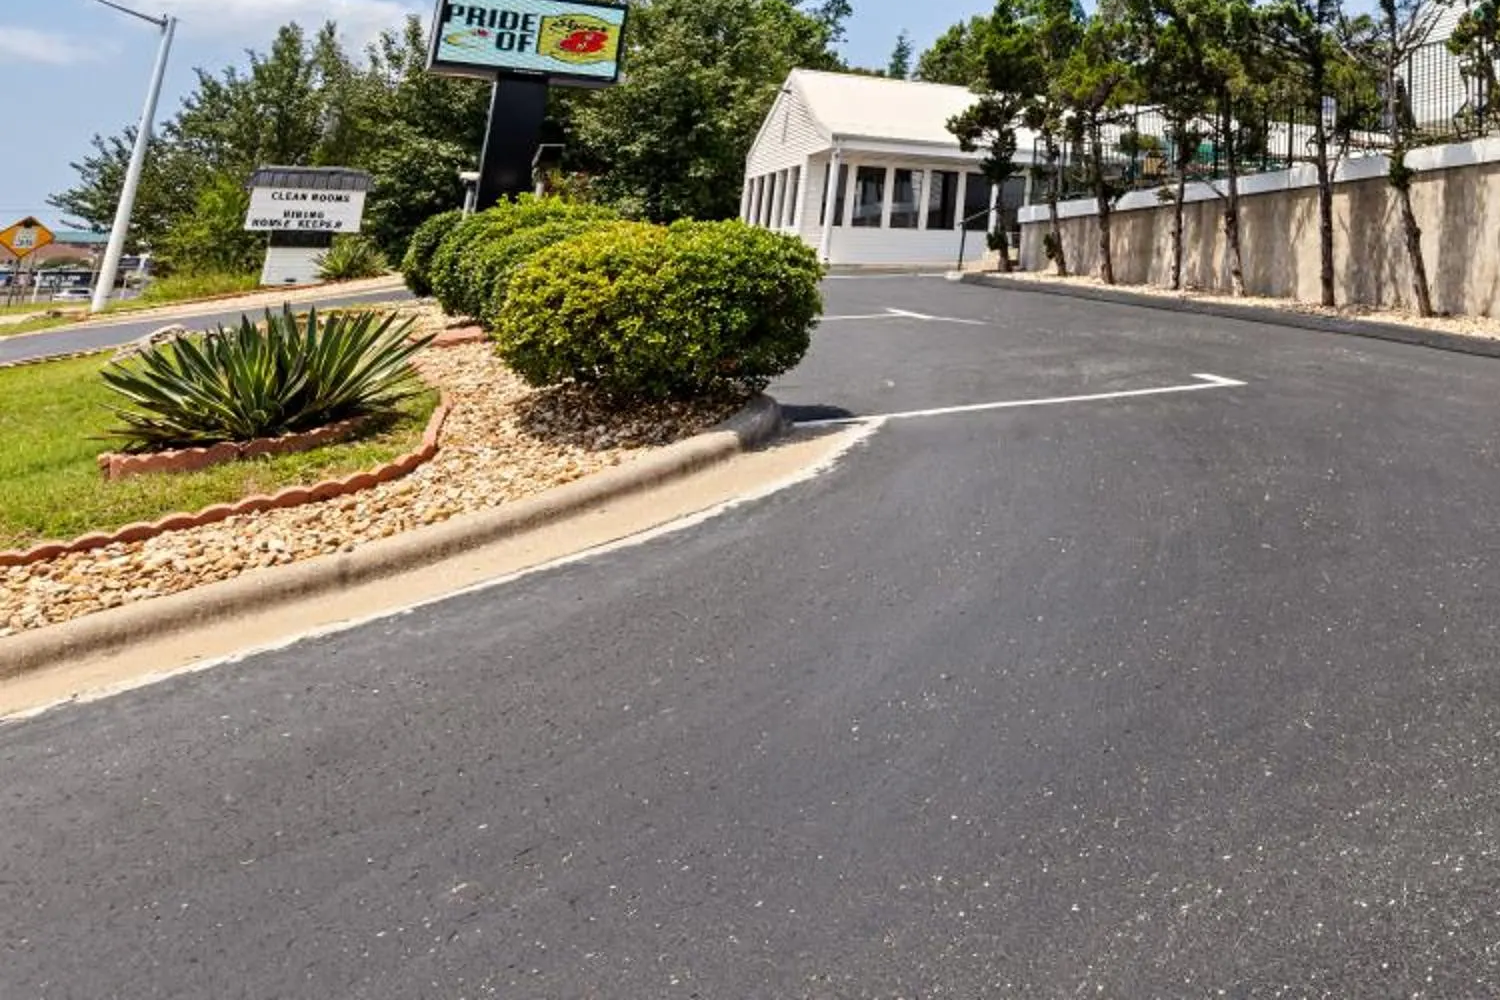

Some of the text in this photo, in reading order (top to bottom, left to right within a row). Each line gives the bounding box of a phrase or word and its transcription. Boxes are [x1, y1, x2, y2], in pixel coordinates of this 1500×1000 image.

[442, 3, 540, 32] PRIDE
[494, 31, 534, 53] OF
[271, 192, 351, 203] CLEAN ROOMS
[283, 210, 325, 219] HIRING
[252, 219, 343, 229] HOUSE KEEPER
